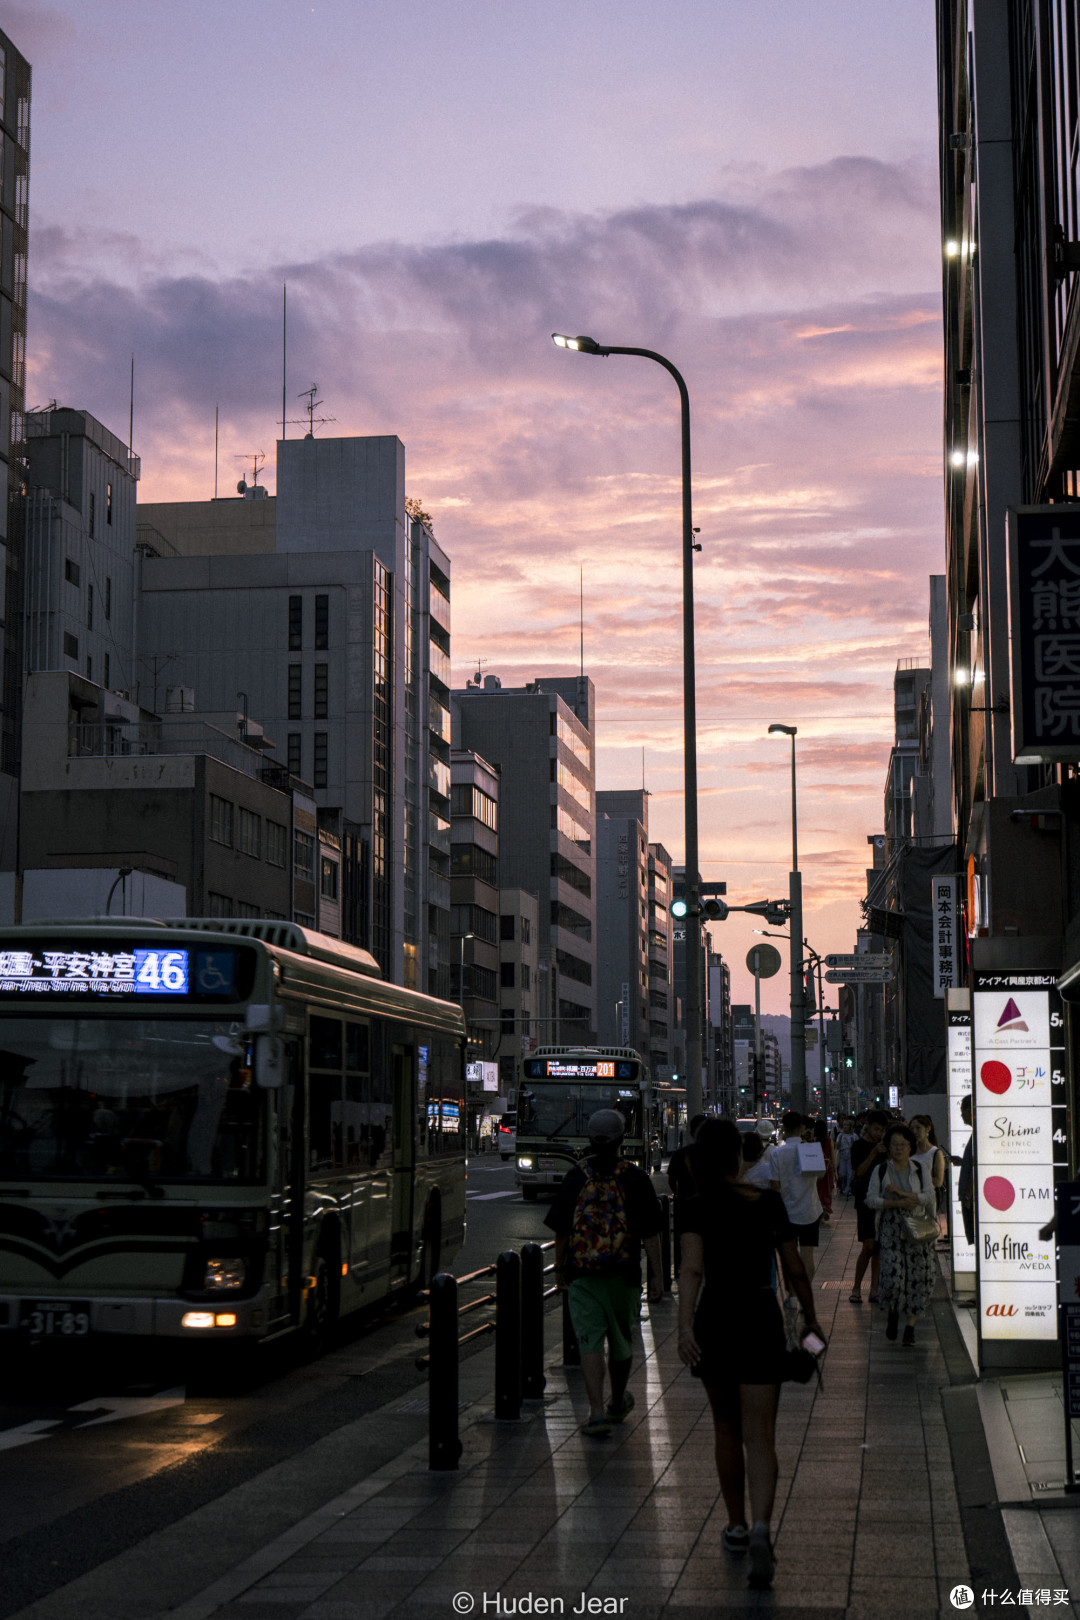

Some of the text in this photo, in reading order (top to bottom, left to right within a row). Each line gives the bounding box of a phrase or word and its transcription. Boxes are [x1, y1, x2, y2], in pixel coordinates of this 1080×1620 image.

[937, 885, 953, 988] 岡本会計事務所
[138, 952, 186, 990] 46
[1050, 1012, 1063, 1027] 5F
[598, 1062, 614, 1077] 201
[1016, 1066, 1046, 1078] ゴール
[1052, 1070, 1065, 1084] 5F
[1016, 1079, 1045, 1090] フリー
[989, 1116, 1041, 1139] Shime
[1052, 1128, 1067, 1144] 4F
[1019, 1188, 1050, 1199] TAM
[1019, 1262, 1052, 1270] AVEDA
[985, 1304, 1019, 1317] au
